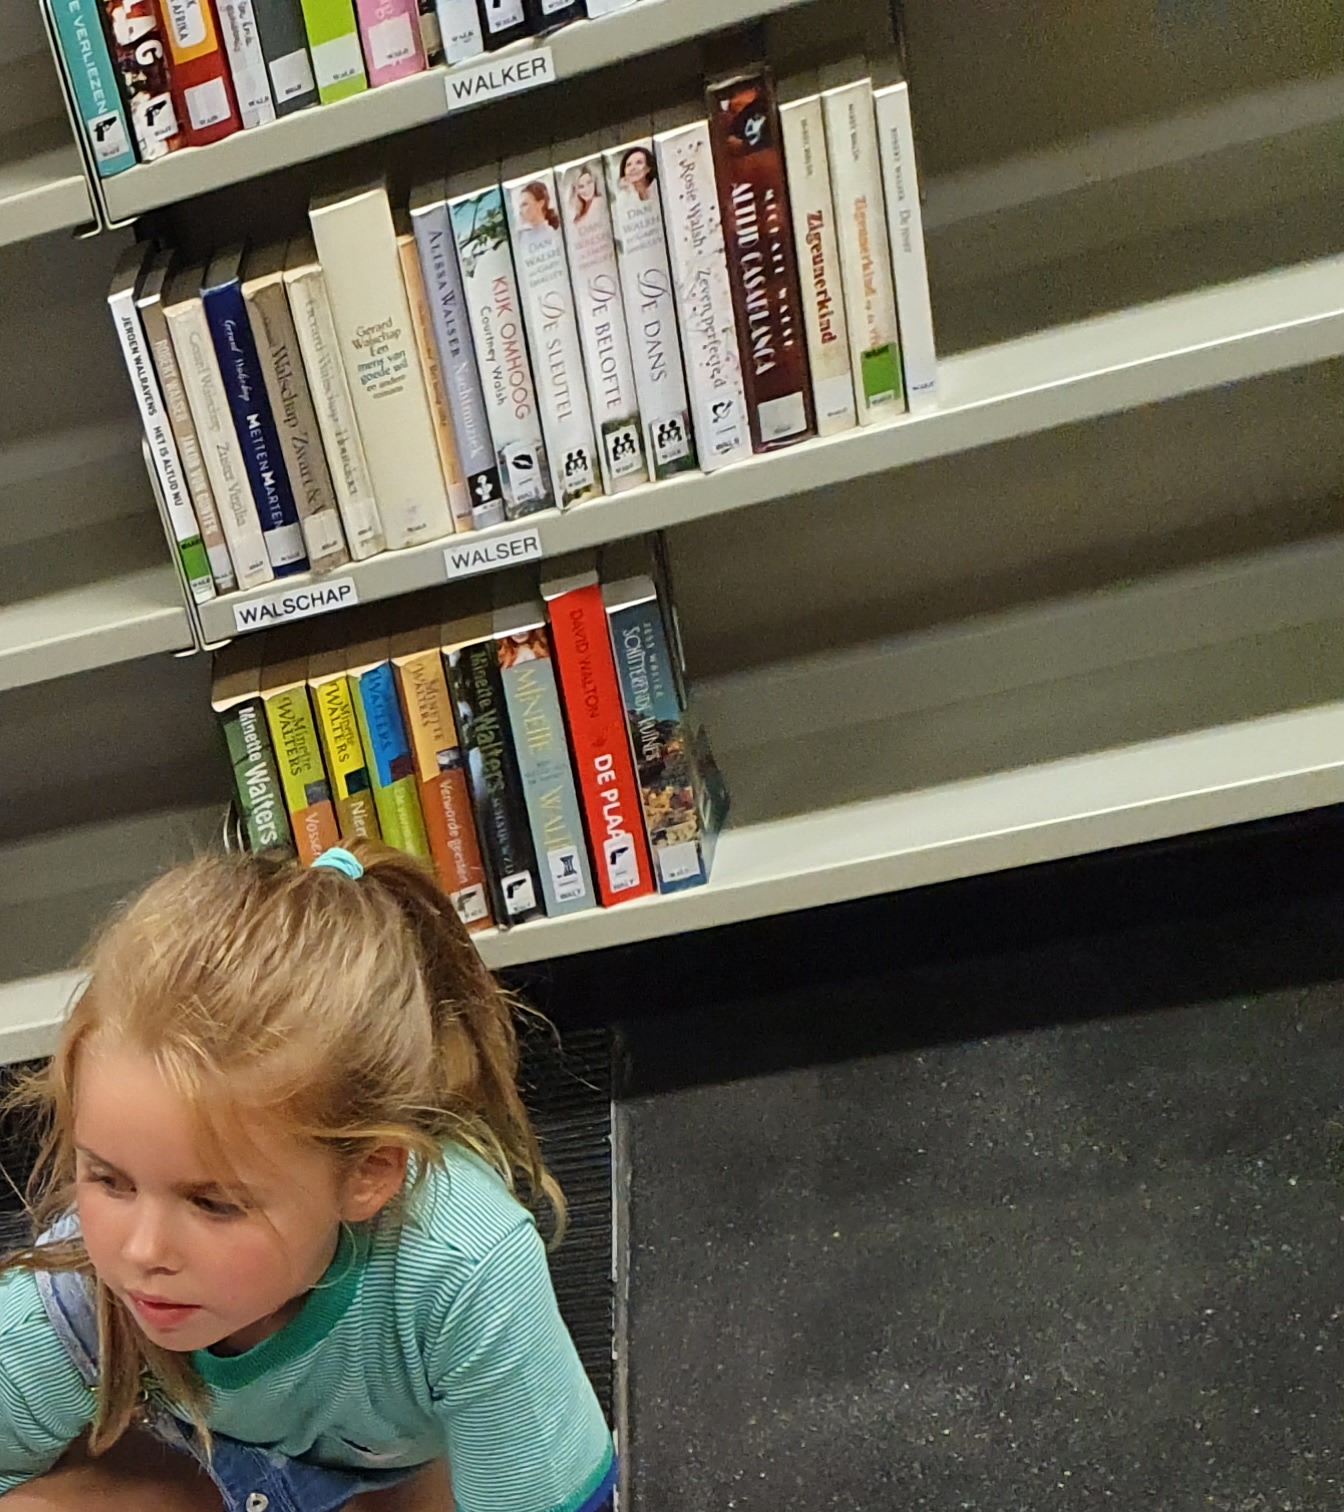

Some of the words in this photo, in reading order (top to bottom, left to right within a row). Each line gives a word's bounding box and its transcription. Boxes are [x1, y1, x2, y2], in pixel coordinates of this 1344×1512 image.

[171, 5, 189, 41] AFRIKA
[71, 14, 107, 114] VERLIEZEN
[452, 57, 546, 99] WALKER
[680, 162, 696, 201] Rosie
[687, 203, 706, 249] Walsh
[427, 230, 446, 291] ALISSA
[441, 290, 461, 358] WALSER
[806, 210, 837, 344] Zigeunerkind
[352, 329, 402, 350] Walschap
[356, 317, 394, 338] Gerard
[479, 306, 499, 365] Courtney
[491, 368, 506, 405] Walsh
[491, 276, 511, 318] KIJK
[501, 322, 531, 420] OMHOOG
[591, 306, 623, 410] BELOFTE
[644, 320, 667, 383] DANS
[121, 316, 138, 352] JEROEN
[132, 354, 158, 417] WALRAVENS
[545, 337, 574, 422] SLEUTEL
[153, 426, 164, 444] HET
[163, 459, 179, 492] ALTIJD
[451, 537, 538, 569] WALSER
[239, 586, 351, 624] WALSCHAP
[570, 609, 588, 658] DAVID
[470, 651, 491, 708] Minette
[577, 656, 600, 719] WALTON
[239, 706, 262, 762] Minette
[276, 697, 303, 777] WALTERS
[324, 681, 350, 763] WALTERS
[474, 709, 505, 798] Walters
[593, 753, 616, 786] DE
[244, 762, 278, 845] Walters
